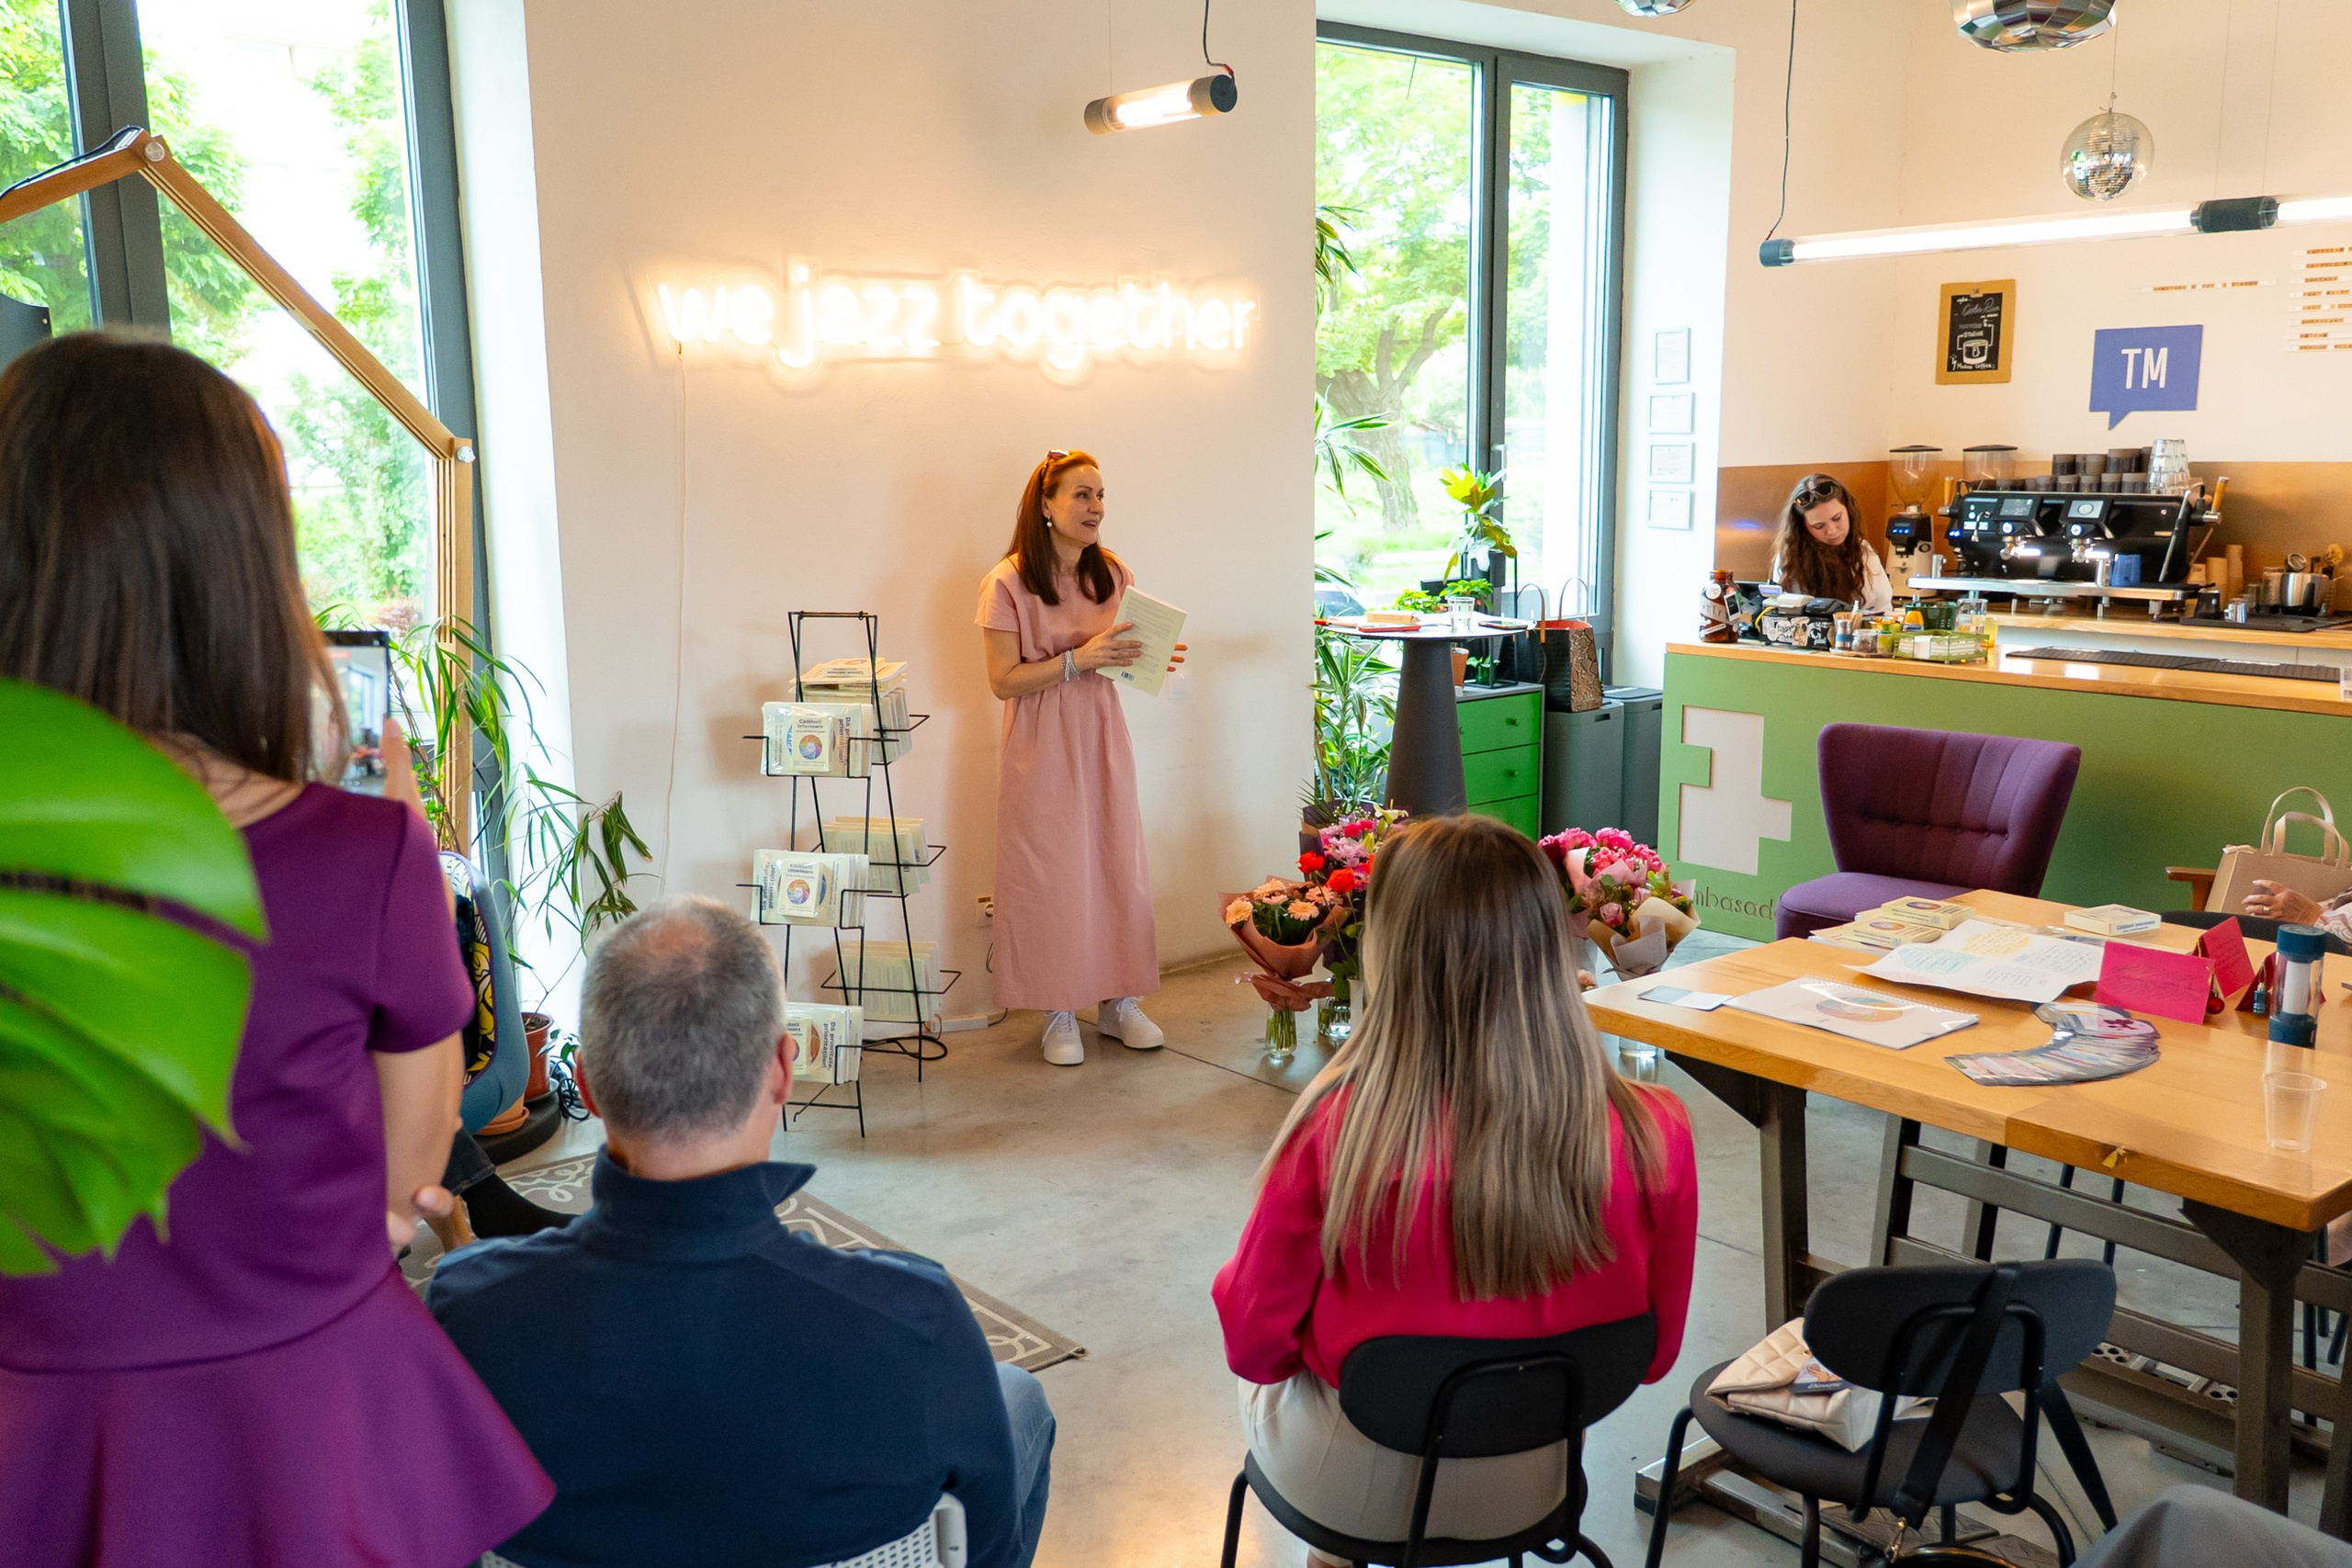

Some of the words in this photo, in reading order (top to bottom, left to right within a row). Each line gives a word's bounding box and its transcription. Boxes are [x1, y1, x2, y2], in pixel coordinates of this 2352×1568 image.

[658, 284, 775, 344] we
[779, 264, 942, 368] jazz
[960, 275, 1256, 368] together
[2120, 347, 2168, 389] TM
[1694, 886, 1777, 920] mbasad
